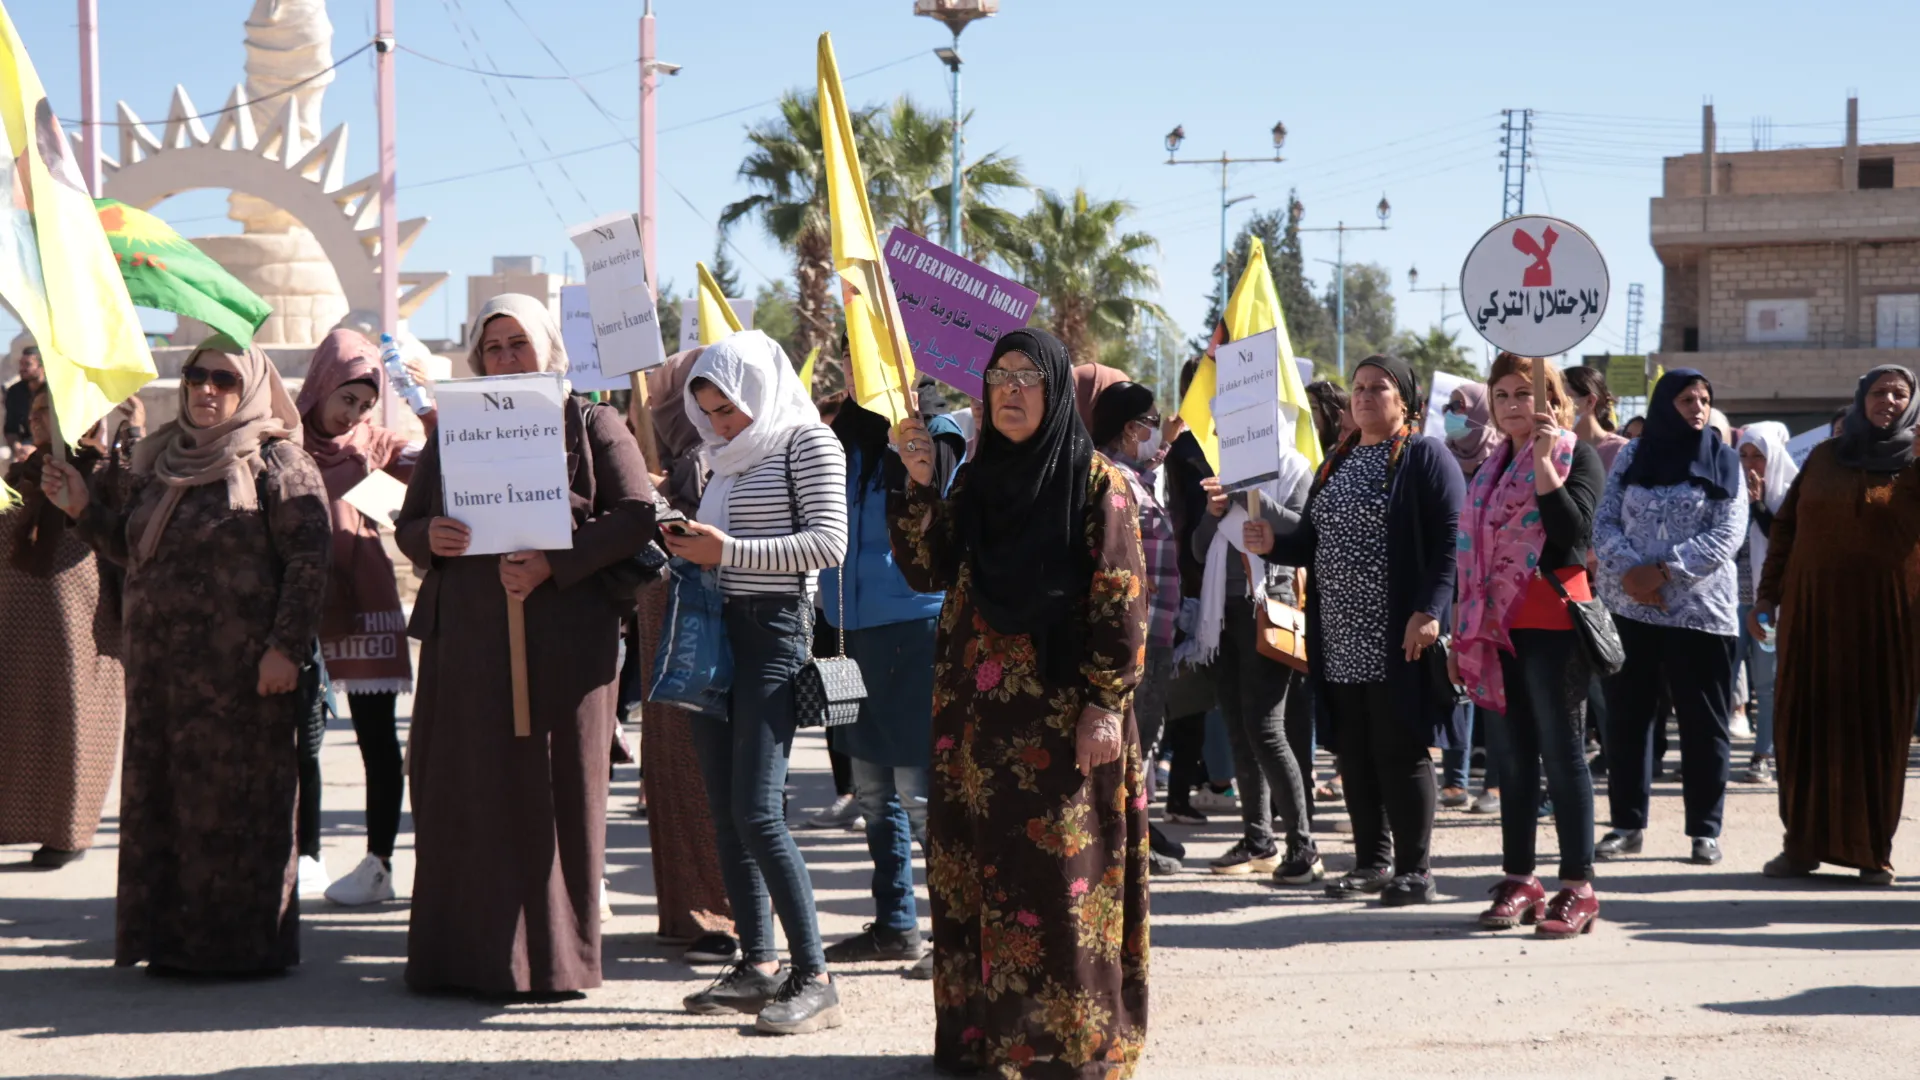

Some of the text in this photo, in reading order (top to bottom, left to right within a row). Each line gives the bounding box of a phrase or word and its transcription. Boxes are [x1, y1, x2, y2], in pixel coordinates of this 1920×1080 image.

[593, 227, 615, 243] Na
[592, 258, 608, 272] dakr
[632, 248, 641, 259] re
[890, 240, 1029, 320] BIJÎ BERXWEDANA ÎMRALI
[929, 296, 972, 330] مقاومة
[1477, 288, 1599, 331] للإحتلال التركي
[597, 309, 653, 337] bimre Îxanet
[974, 323, 1004, 344] اشت
[1238, 349, 1253, 366] Na
[1218, 382, 1225, 396] ji
[1225, 378, 1243, 392] dakr
[1266, 368, 1274, 378] re
[481, 392, 515, 412] Na
[444, 424, 558, 446] ji dakr keriyê re
[1221, 426, 1274, 450] bimre Îxanet
[454, 483, 563, 507] bimre Îxanet
[668, 616, 700, 692] JEANS
